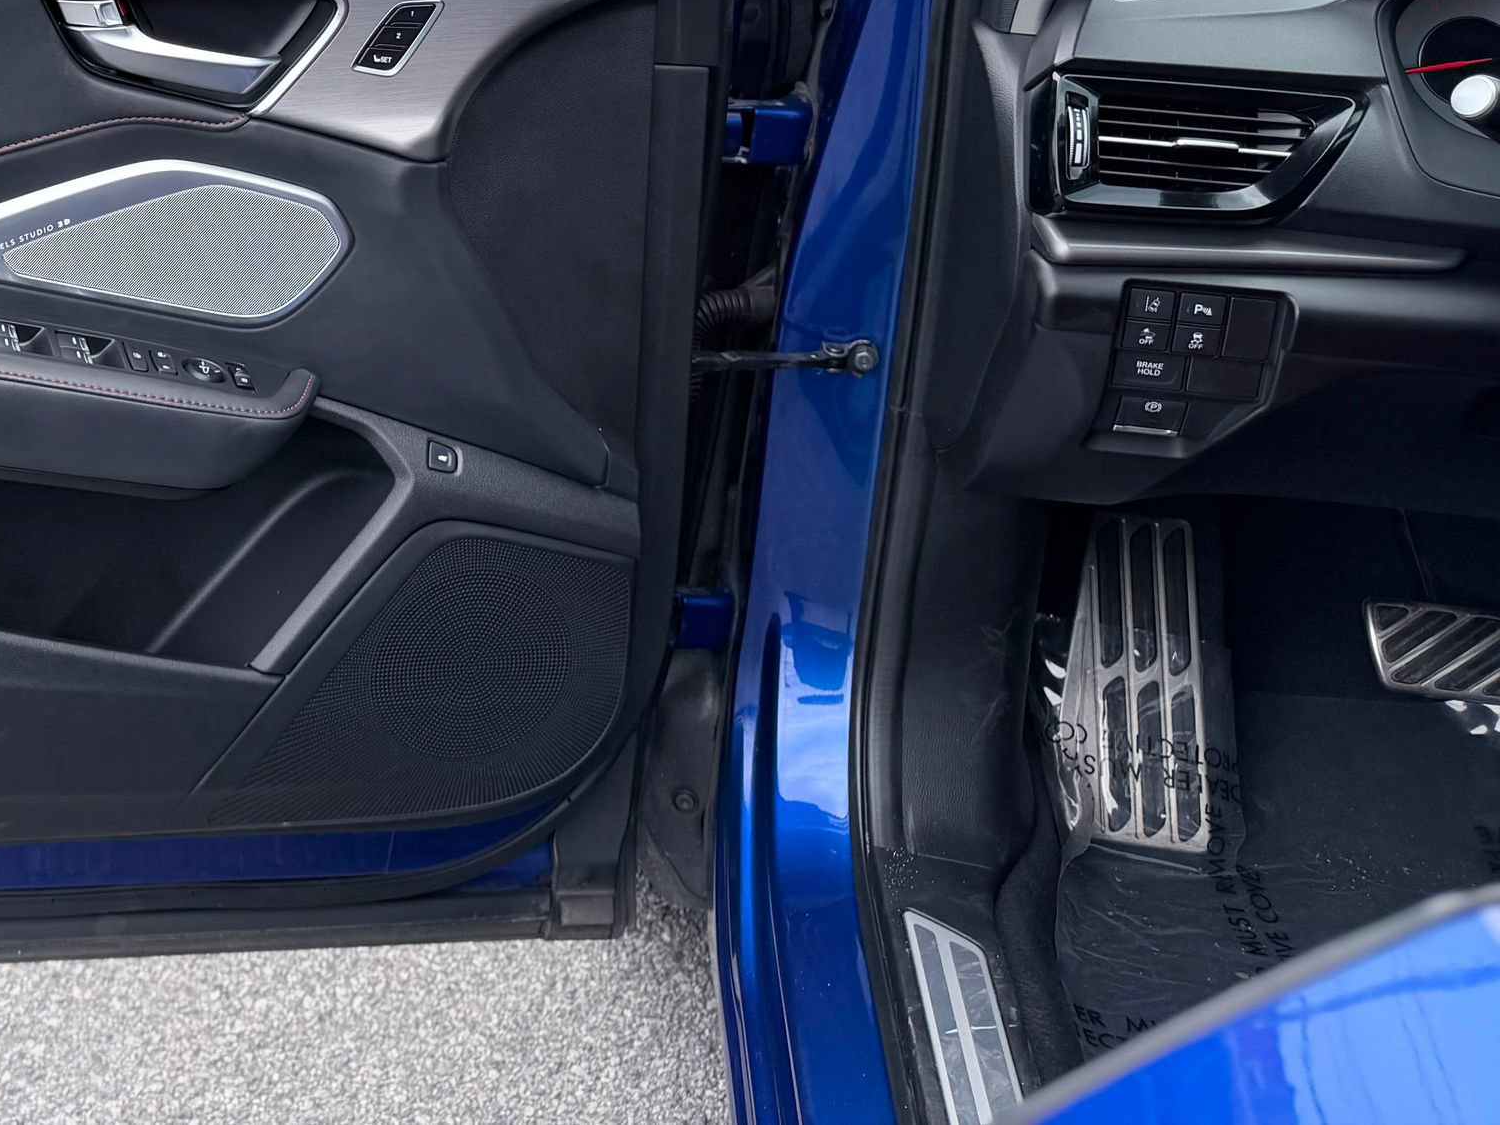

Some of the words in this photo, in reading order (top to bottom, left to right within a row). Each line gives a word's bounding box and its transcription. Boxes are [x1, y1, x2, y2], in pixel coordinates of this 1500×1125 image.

[0, 238, 16, 250] ELS
[19, 224, 54, 243] STUDIO
[57, 218, 71, 228] 3D
[1136, 360, 1164, 370] BRAKE
[1137, 368, 1161, 377] HOLD
[1222, 904, 1269, 957] MUST
